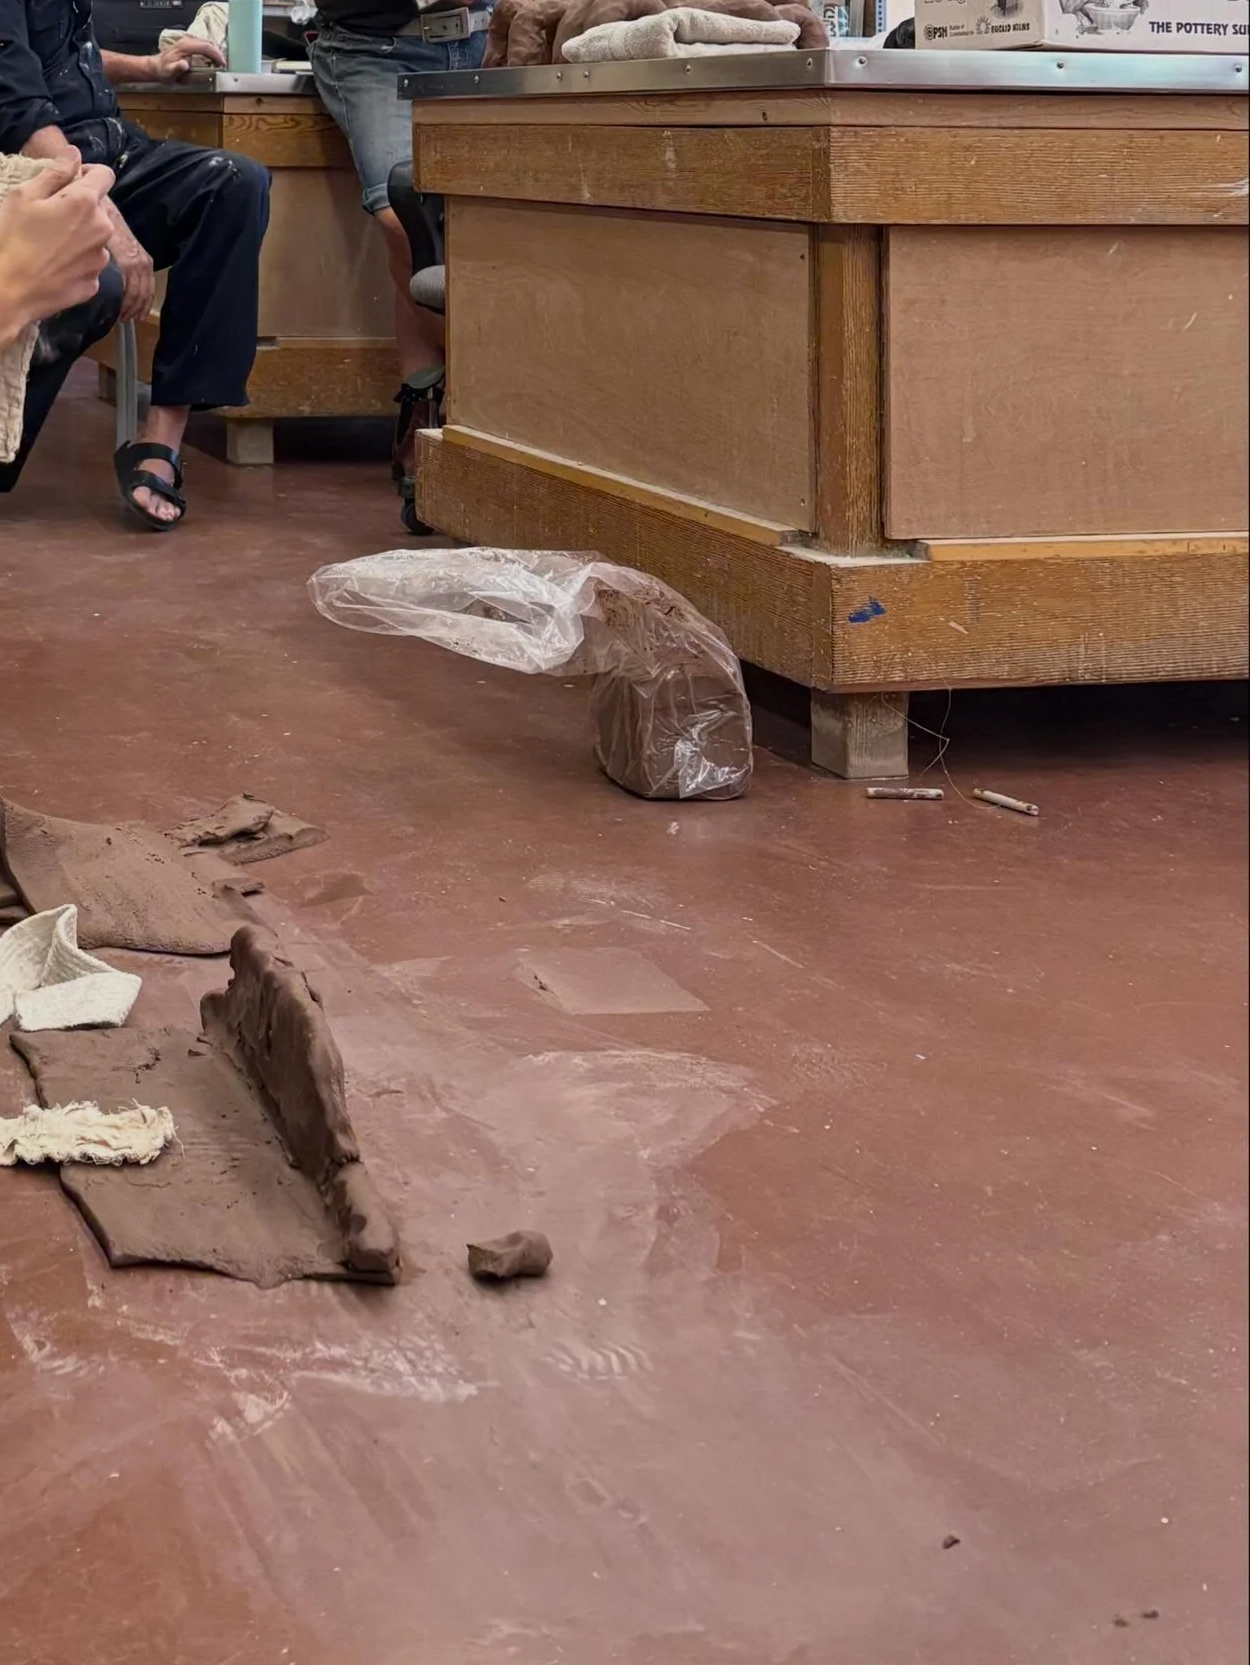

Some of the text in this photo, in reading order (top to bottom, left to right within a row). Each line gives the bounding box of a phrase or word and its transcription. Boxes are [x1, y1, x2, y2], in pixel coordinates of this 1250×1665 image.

[991, 23, 1030, 33] EUCLID KILNS
[1149, 21, 1249, 36] THE POTTERY SU
